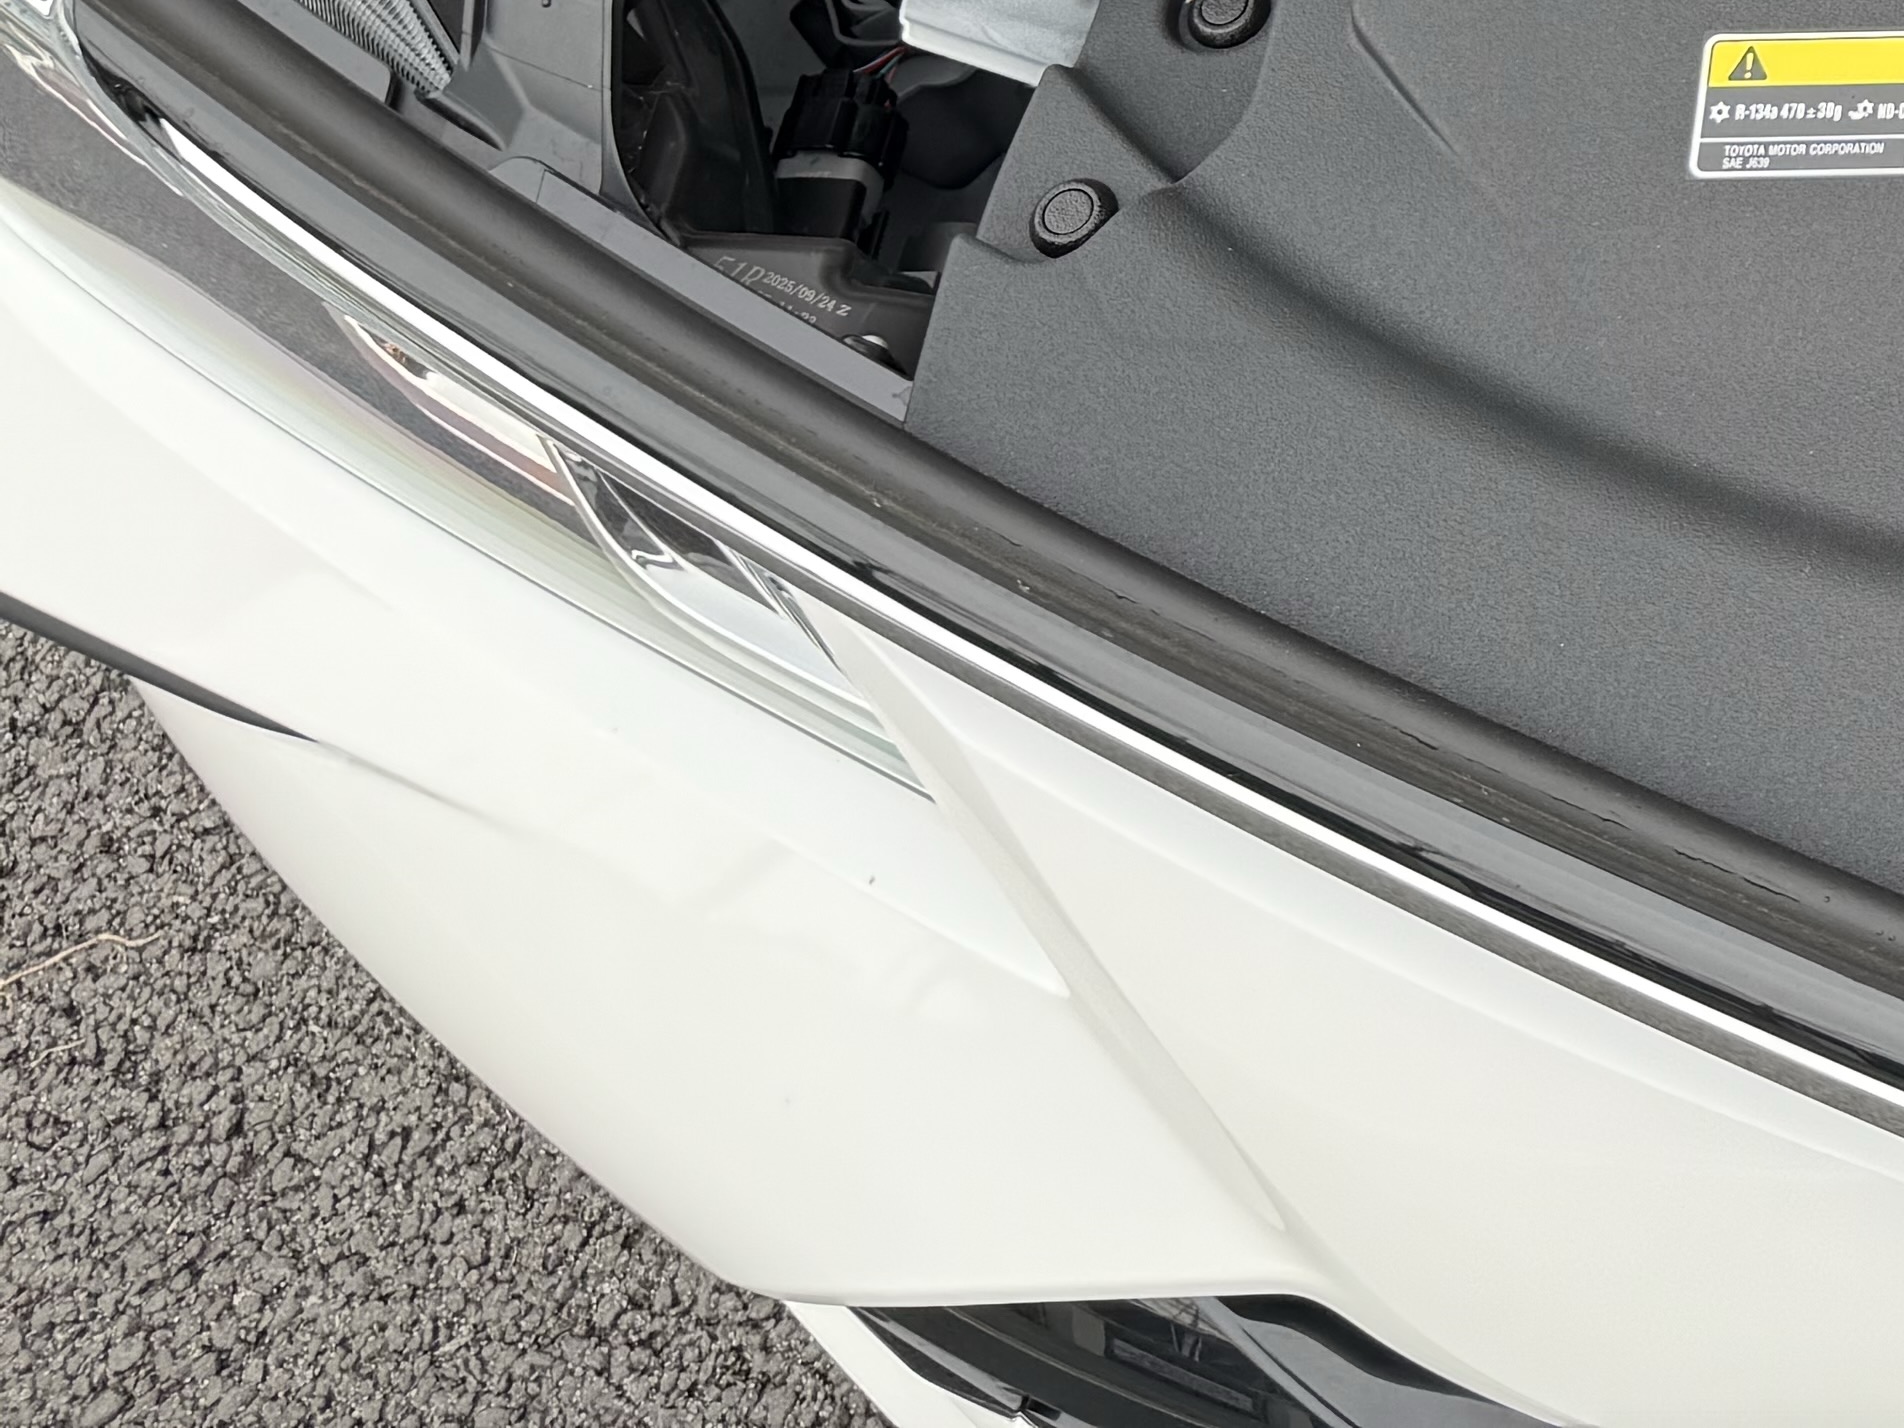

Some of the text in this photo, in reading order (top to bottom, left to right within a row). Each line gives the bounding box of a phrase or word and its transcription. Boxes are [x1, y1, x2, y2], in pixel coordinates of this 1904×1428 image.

[1724, 142, 1885, 157] TOYOTA MOTOR CORPORATION
[1722, 156, 1742, 169] SAE
[763, 271, 837, 312] 2025/09/24
